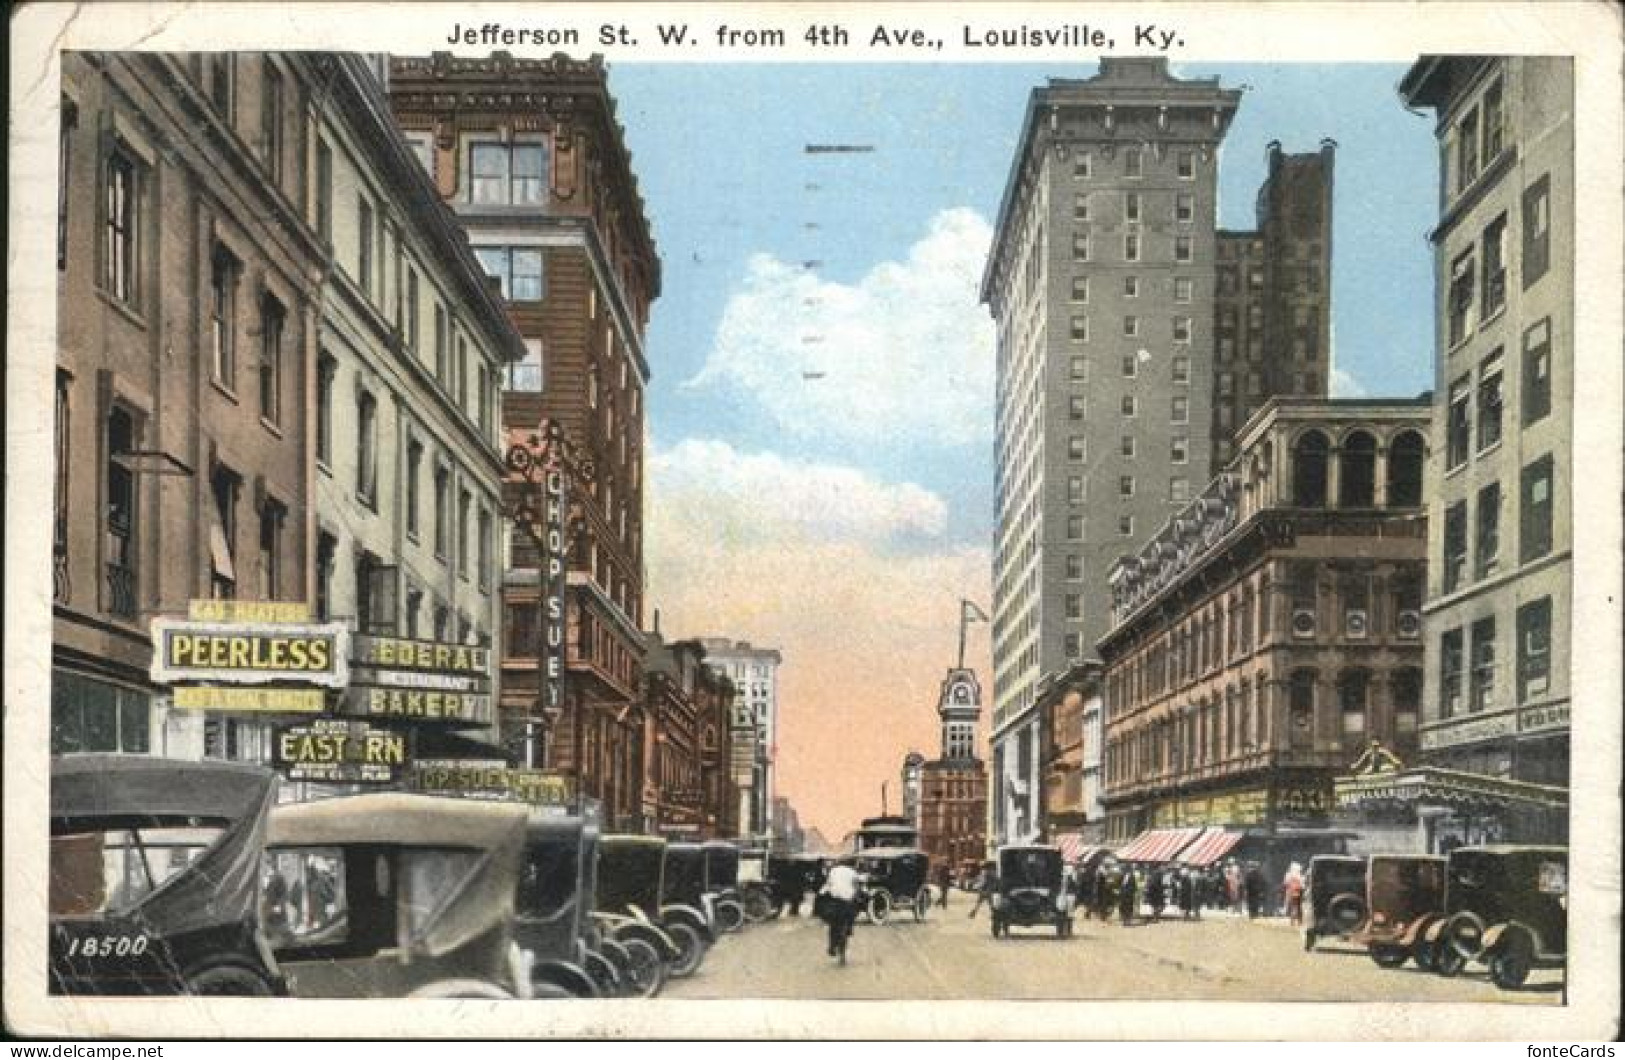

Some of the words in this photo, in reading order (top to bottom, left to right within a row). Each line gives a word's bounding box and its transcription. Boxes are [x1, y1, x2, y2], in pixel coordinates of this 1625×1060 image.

[446, 25, 579, 45] Jefferson
[600, 25, 637, 45] St.
[658, 25, 697, 45] W.
[716, 25, 783, 45] from
[805, 25, 848, 45] 4th
[870, 25, 943, 49] Ave.,
[965, 25, 1115, 48] Louisville,
[1135, 25, 1185, 50] Ky.
[171, 634, 329, 670] PEERLESS
[280, 732, 405, 762] EASTRN
[68, 934, 149, 957] 18500
